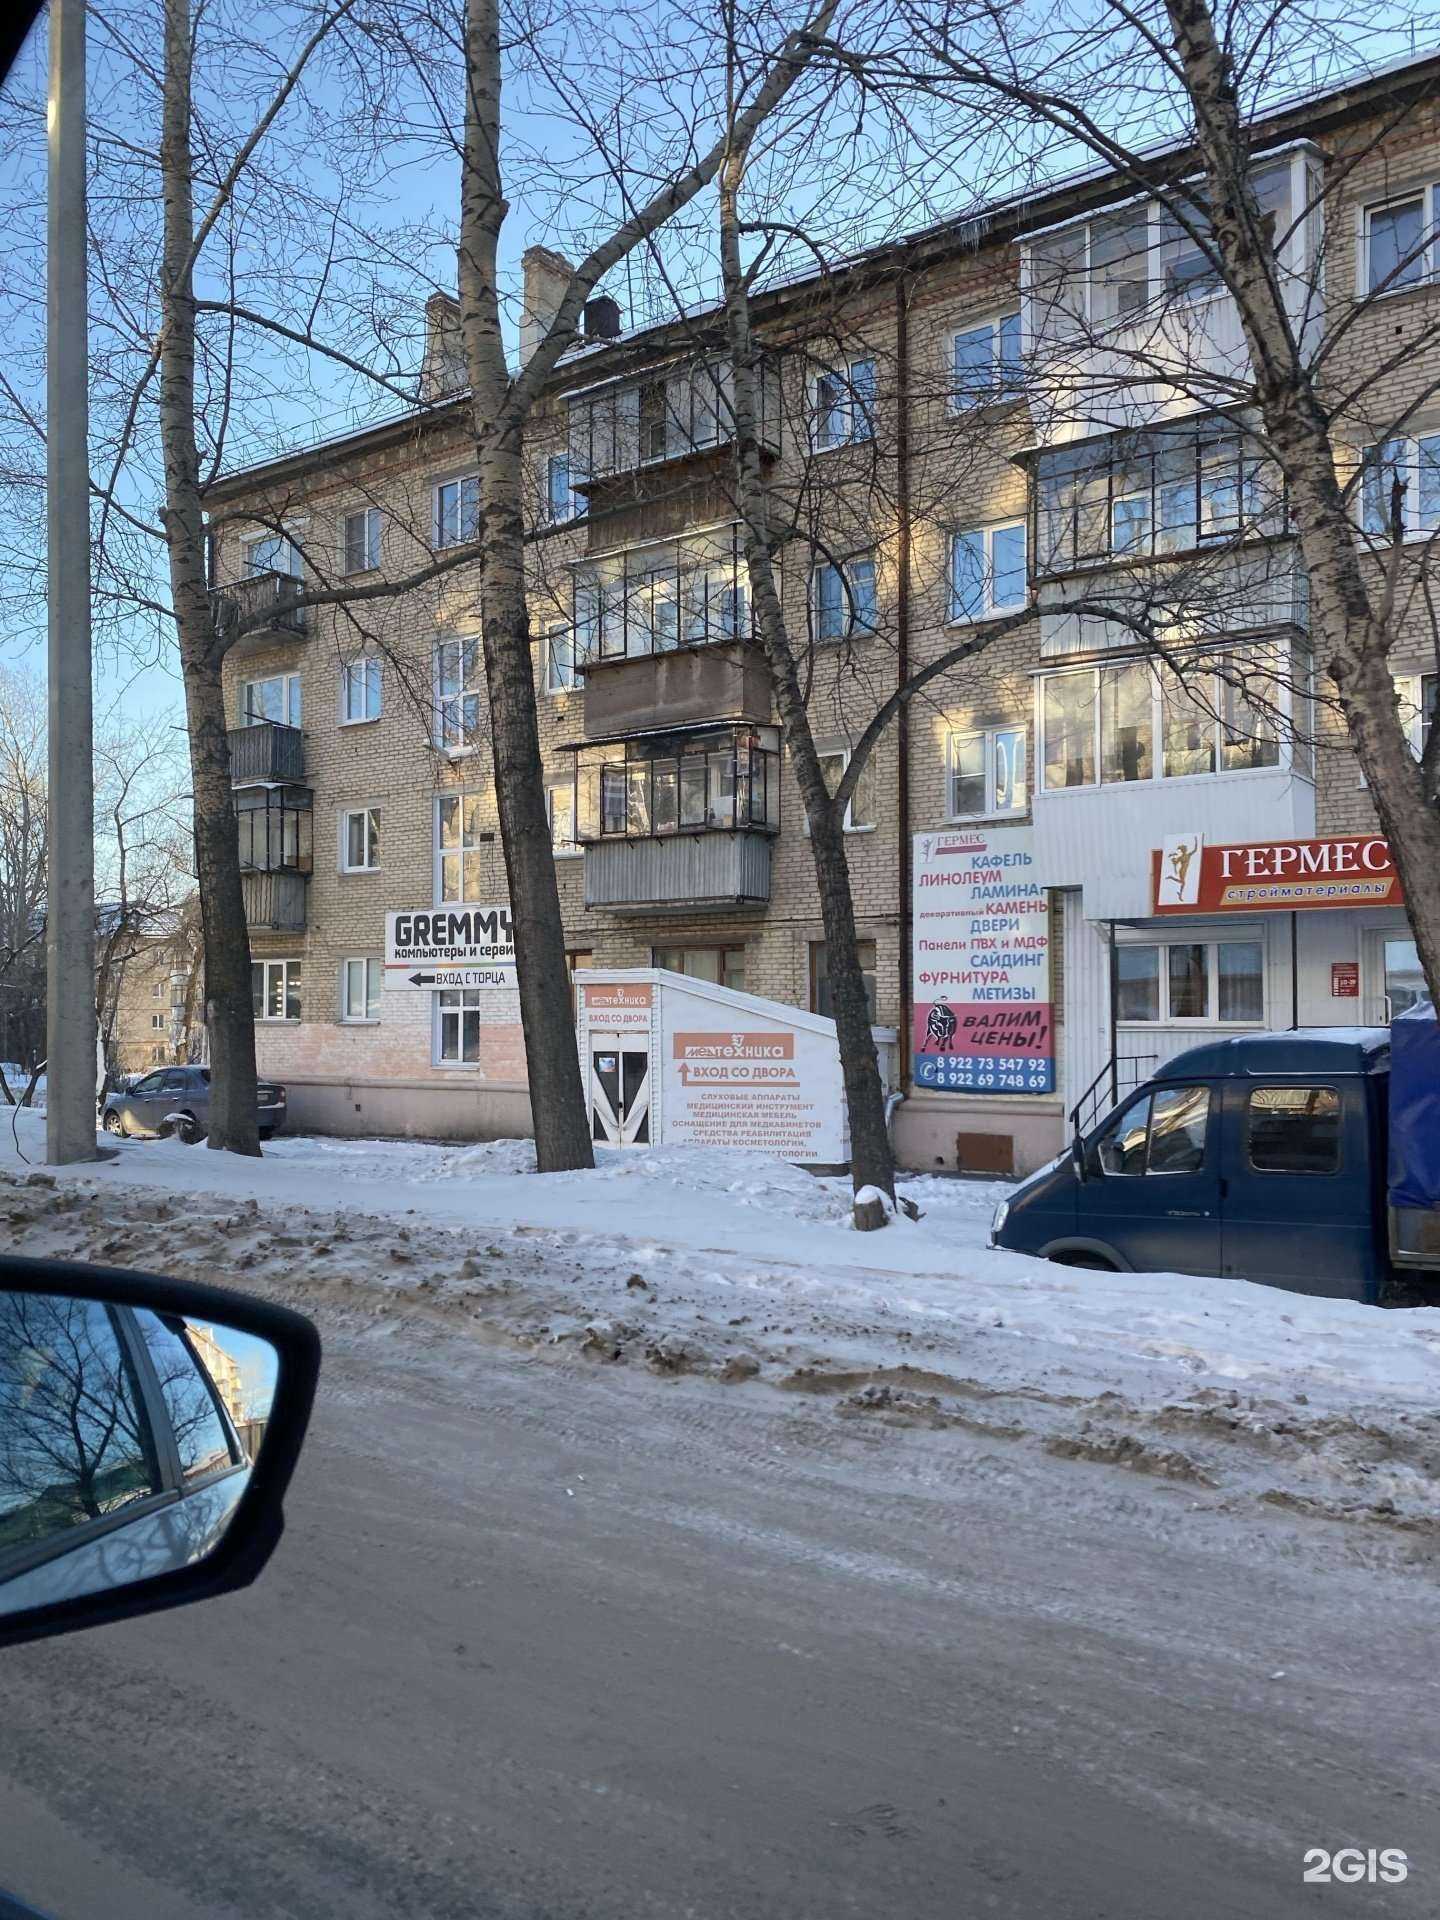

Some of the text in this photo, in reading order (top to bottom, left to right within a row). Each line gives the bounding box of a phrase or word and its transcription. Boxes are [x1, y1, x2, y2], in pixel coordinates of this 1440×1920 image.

[937, 833, 985, 847] ГЕРМЕС
[971, 853, 1032, 869] КАФЕЛЬ
[1219, 839, 1392, 878] ГЕРМЕС
[919, 870, 1002, 887] ЛИНОЛЕУМ
[1227, 882, 1385, 901] стройматериалы
[986, 901, 1048, 915] КАМЕНЬ
[395, 910, 514, 946] GREMMY
[970, 918, 1020, 934] ДВЕРИ
[919, 936, 1048, 951] Панели ПВХ и МДФ
[395, 946, 467, 960] компьютеры
[469, 946, 477, 957] и
[970, 952, 1045, 969] САЙДИНГ
[436, 971, 506, 985] ВХОД С ТОРЦА
[919, 971, 1009, 986] ФУРНИТУРА
[972, 987, 1036, 1001] МЕТИЗЫ
[589, 1014, 648, 1023] ВХОД СО ДВОРА
[963, 1010, 1042, 1028] ВАЛИМ
[970, 1026, 1048, 1049] ЦЕНЫ!
[937, 1057, 1046, 1072] 8 922 73 547 92
[693, 1066, 796, 1079] ВХОД СО ДВОРА
[937, 1072, 1046, 1088] 8 922 69 748 69
[701, 1093, 801, 1101] СЛУХОВЫЕ АППАРАТЫ
[755, 1103, 815, 1111] ИНСТРУМЕНТ
[692, 1111, 797, 1119] МЕДИЦИНСКАЯ МЕБЕЛЬ
[672, 1120, 822, 1129] ОСНАЩЕНИЕ ДЛЯ МЕДКАБИНЕТОВ
[692, 1129, 738, 1137] СРЕДСТВА
